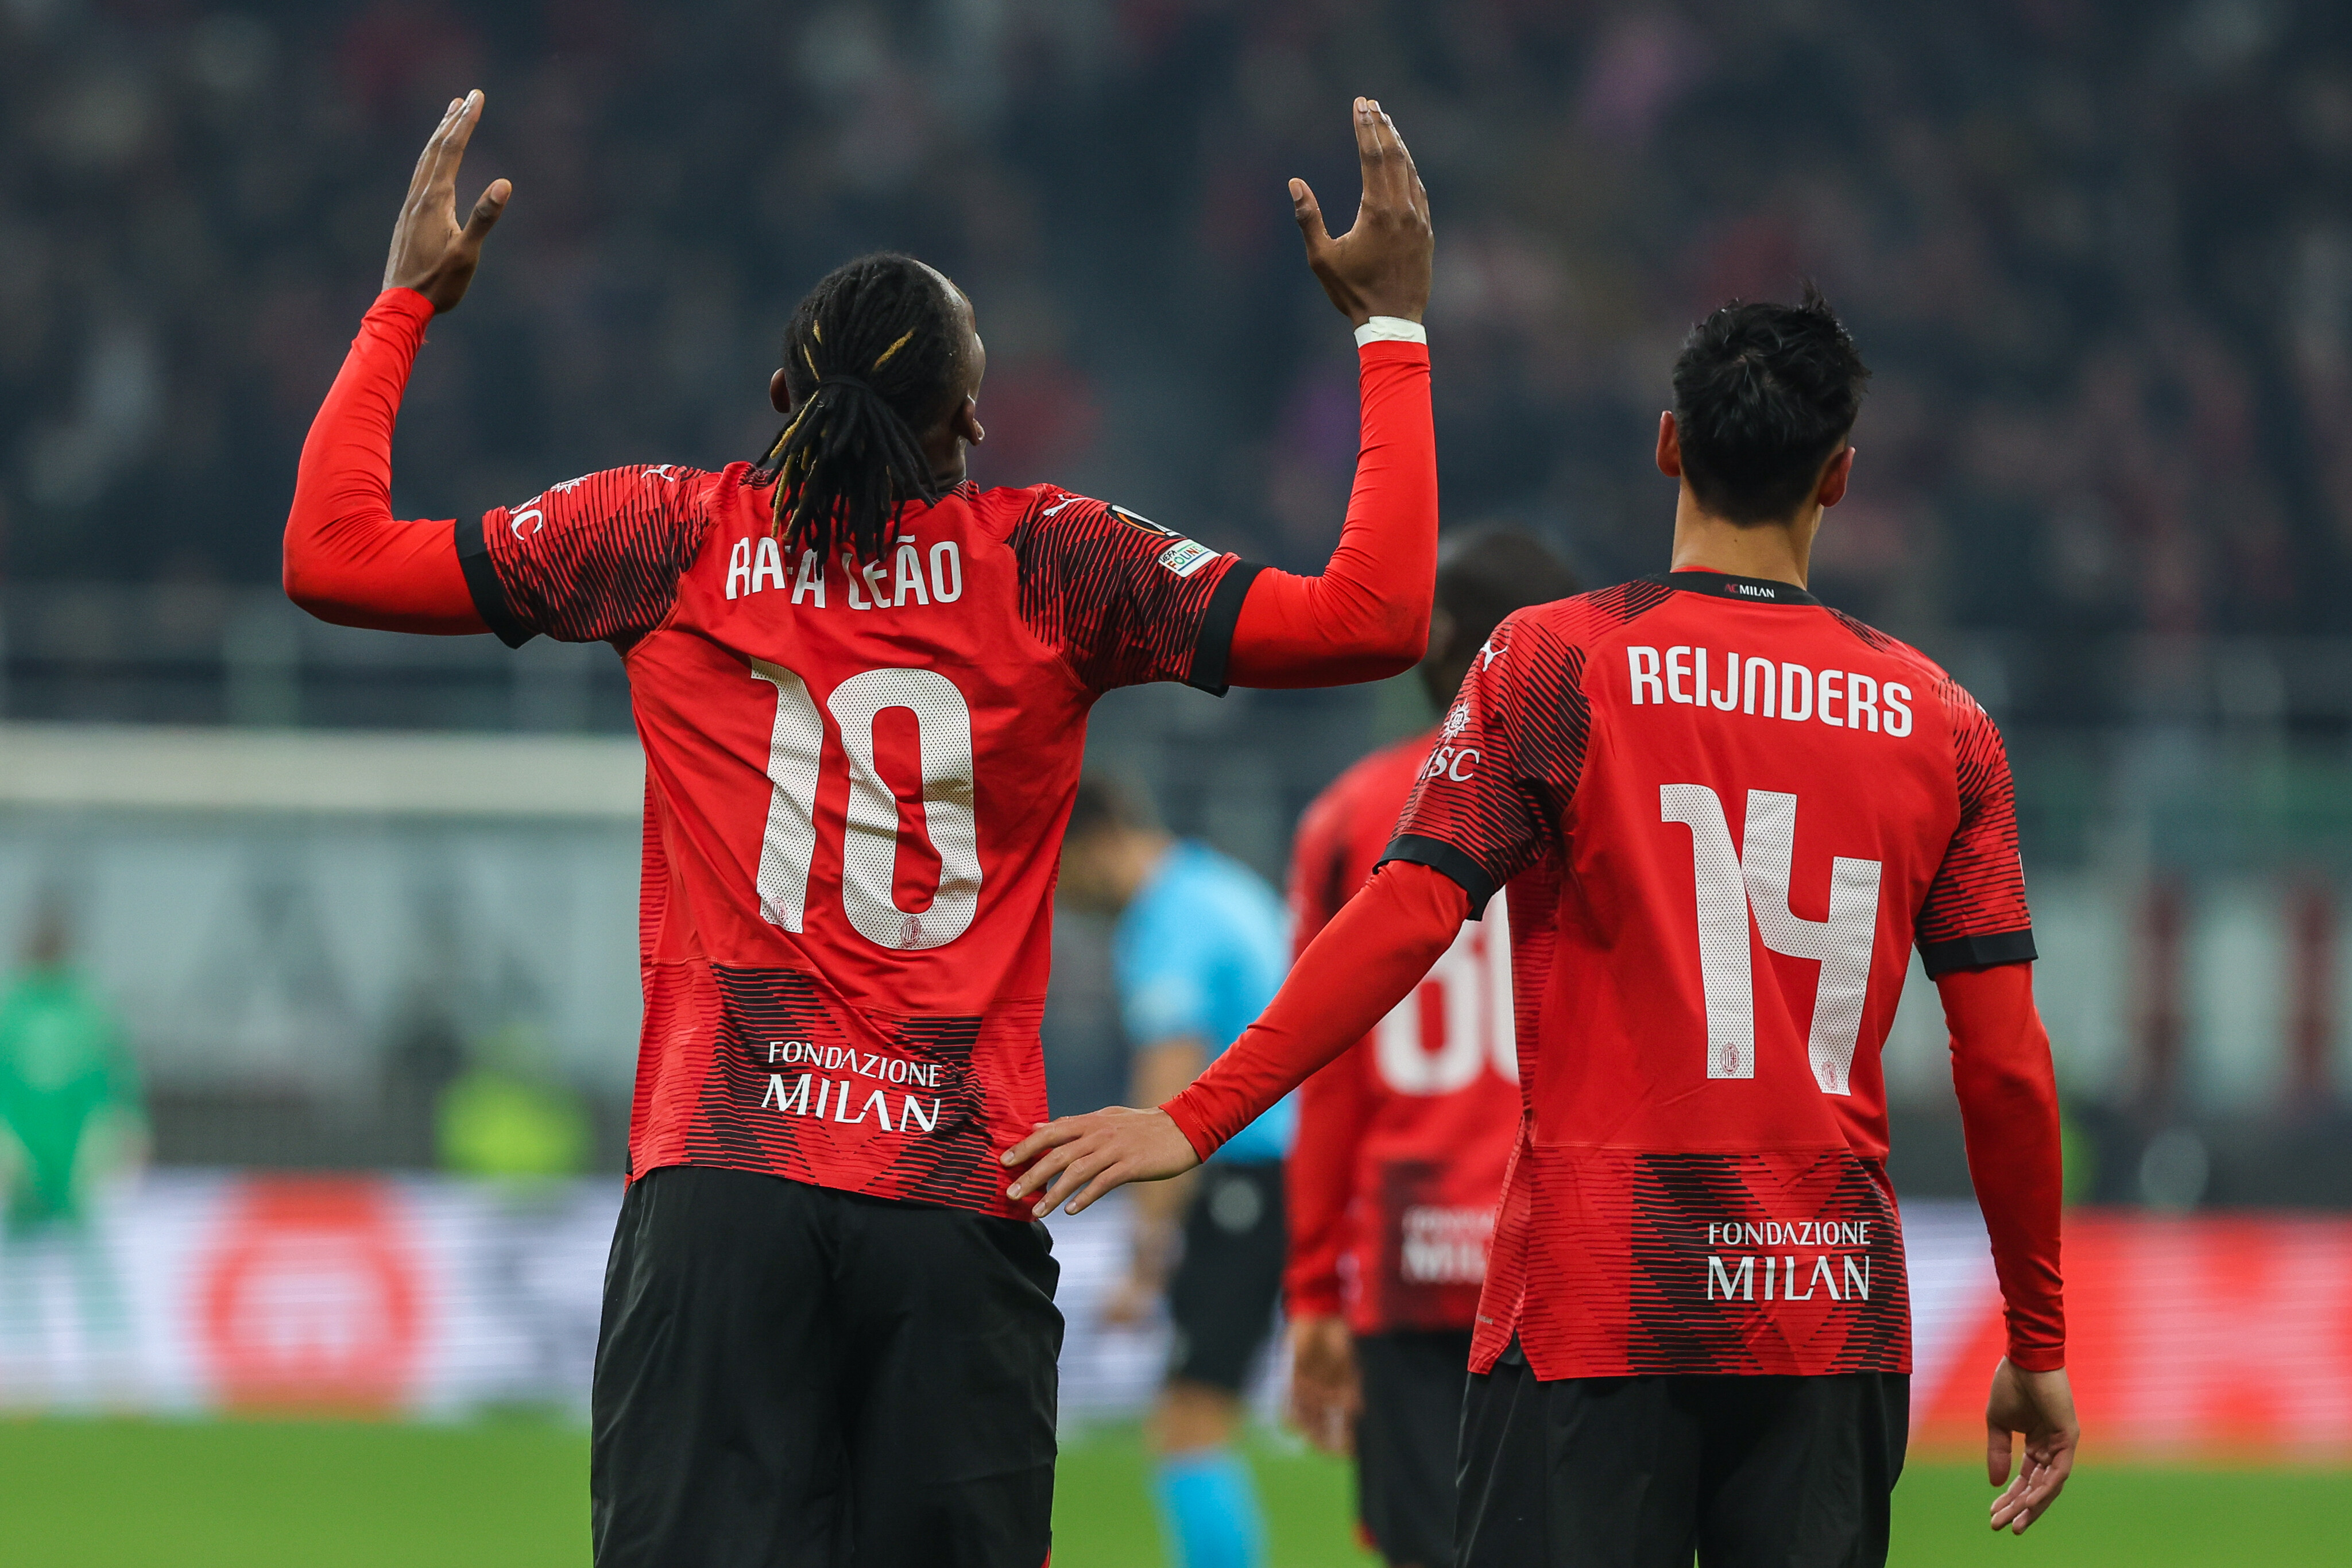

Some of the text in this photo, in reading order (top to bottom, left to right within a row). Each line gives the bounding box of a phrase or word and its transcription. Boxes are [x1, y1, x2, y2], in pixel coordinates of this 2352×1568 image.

[725, 535, 962, 610] RAA LEÃO
[1159, 549, 1178, 563] UEFA
[1739, 584, 1775, 598] MILAN
[1626, 645, 1913, 737] REIJNDERS
[1421, 746, 1480, 782] SC
[749, 655, 983, 950] 10
[1659, 783, 1882, 1096] 14
[768, 1041, 942, 1087] FONDAZIONE
[761, 1073, 941, 1133] MILAN
[1708, 1221, 1871, 1246] FONDAZIONE
[1707, 1255, 1870, 1301] MILAN
